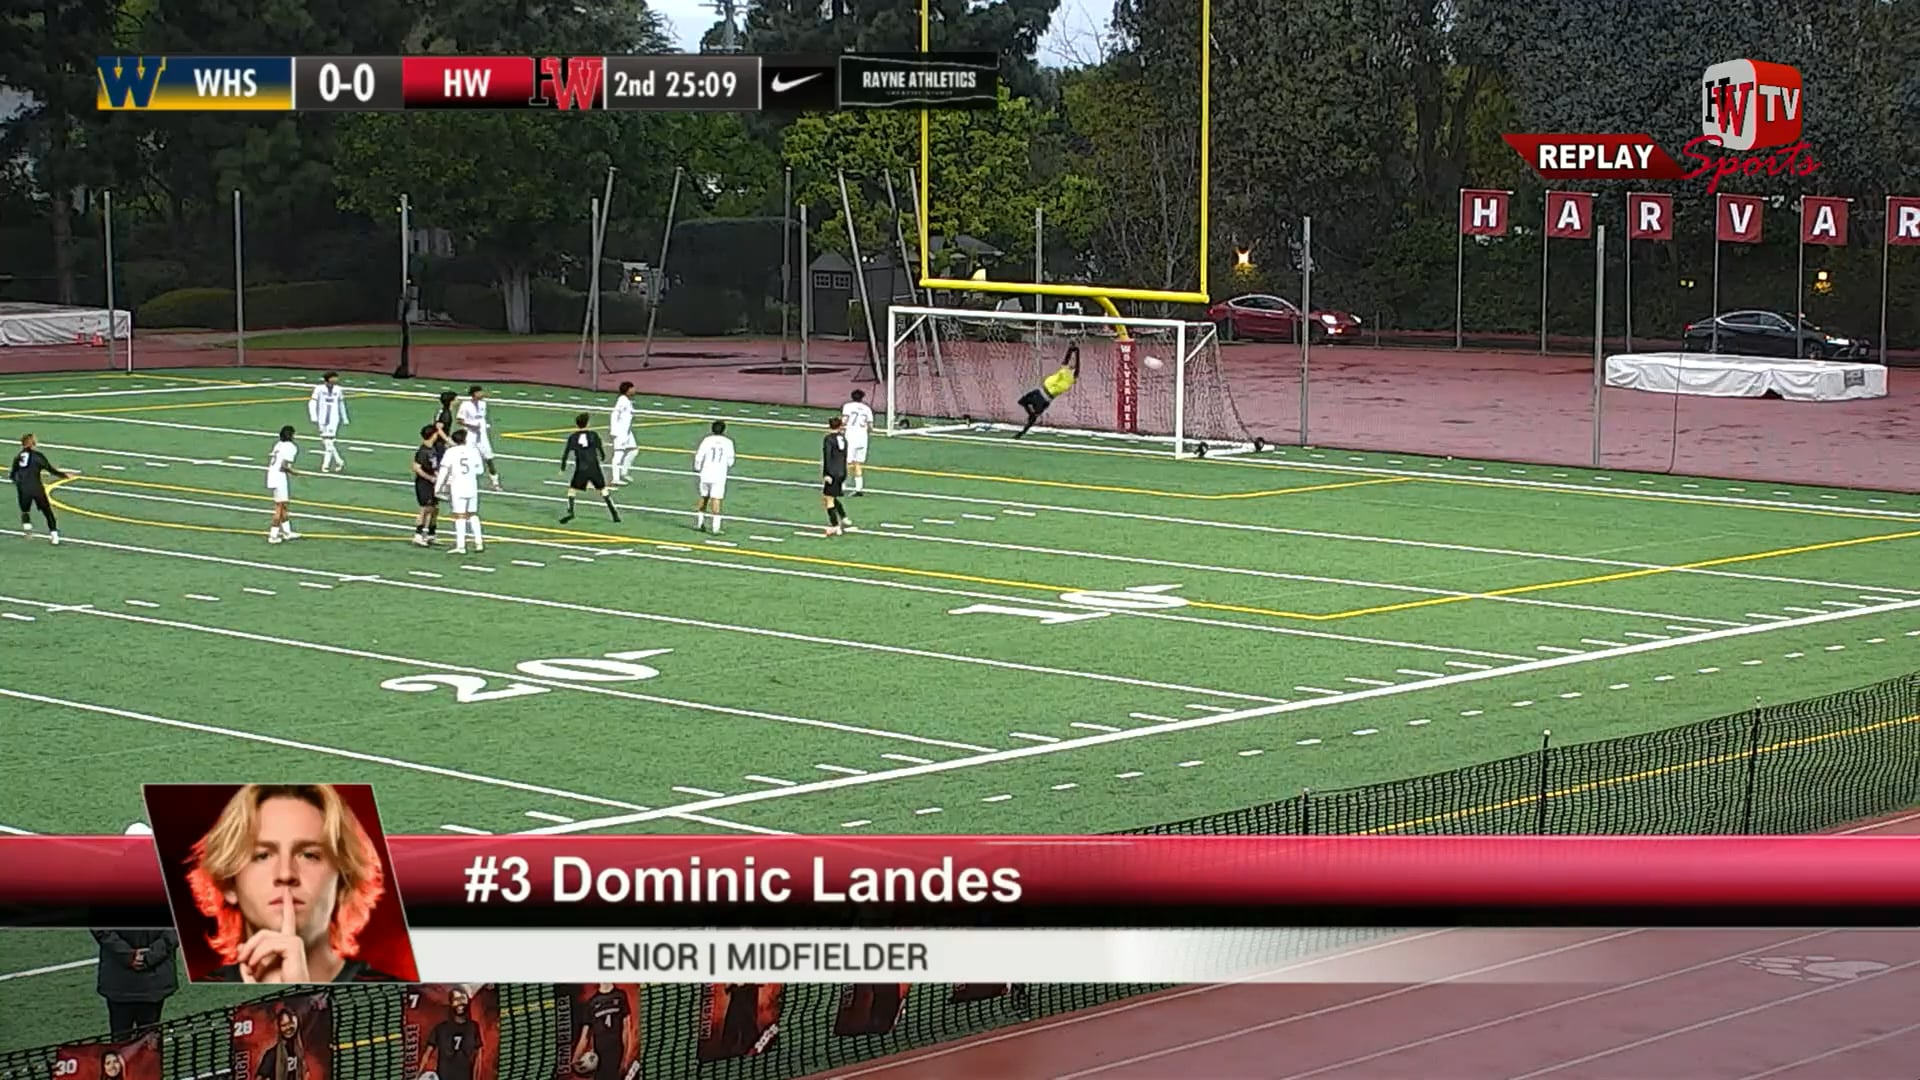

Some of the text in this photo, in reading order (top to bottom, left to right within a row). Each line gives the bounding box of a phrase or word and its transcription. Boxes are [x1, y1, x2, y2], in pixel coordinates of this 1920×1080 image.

[577, 432, 589, 448] 4
[18, 450, 29, 467] 3
[458, 457, 471, 475] 5
[408, 994, 419, 1009] 7
[233, 1020, 254, 1038] 28
[453, 1035, 463, 1051] 7
[54, 1058, 78, 1077] 30
